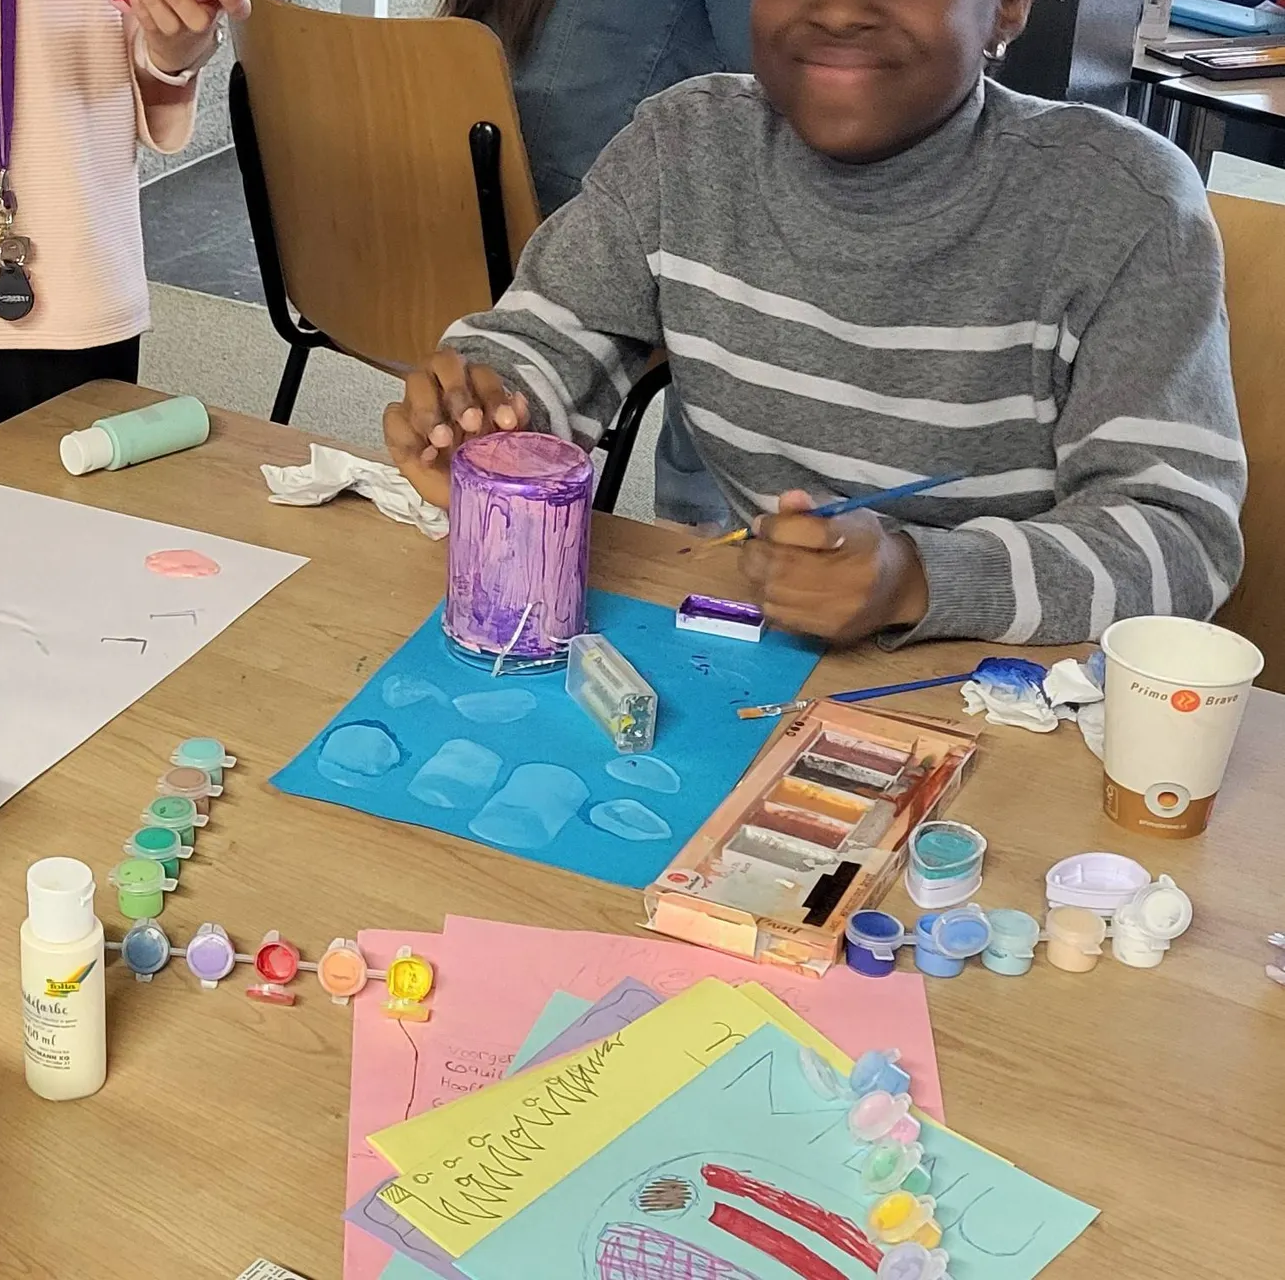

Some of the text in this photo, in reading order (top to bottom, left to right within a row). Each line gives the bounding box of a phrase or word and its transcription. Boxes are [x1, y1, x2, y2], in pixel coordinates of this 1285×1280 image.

[1130, 681, 1239, 707] Primo Bravo
[441, 1076, 484, 1092] Hoof
